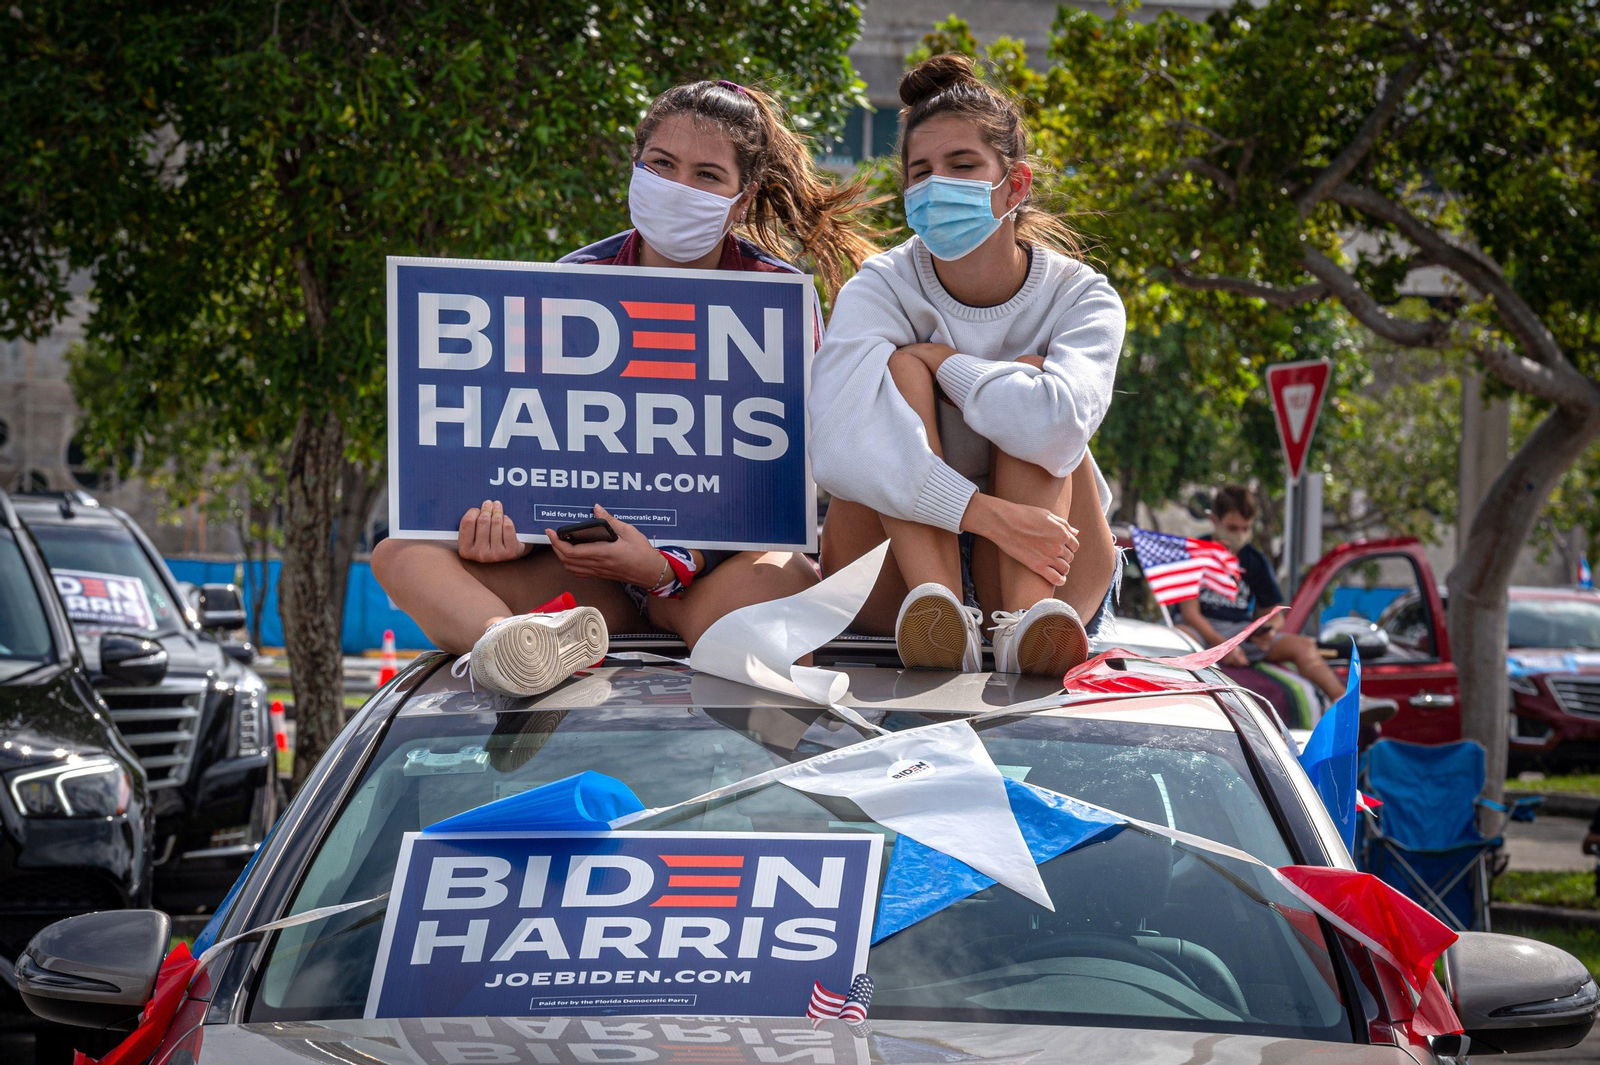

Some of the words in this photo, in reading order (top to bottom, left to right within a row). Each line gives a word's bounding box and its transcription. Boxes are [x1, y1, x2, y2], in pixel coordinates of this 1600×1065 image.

[418, 292, 784, 384] BIDEN
[418, 383, 789, 461] HARRIS
[489, 467, 720, 494] JOEBIDEN.COM
[54, 576, 138, 600] DEN
[65, 596, 145, 617] RRIS
[892, 761, 927, 779] BIDEN
[422, 854, 846, 910] BIDEN
[409, 917, 838, 965] HARRIS
[485, 970, 751, 988] JOEBIDEN.COM
